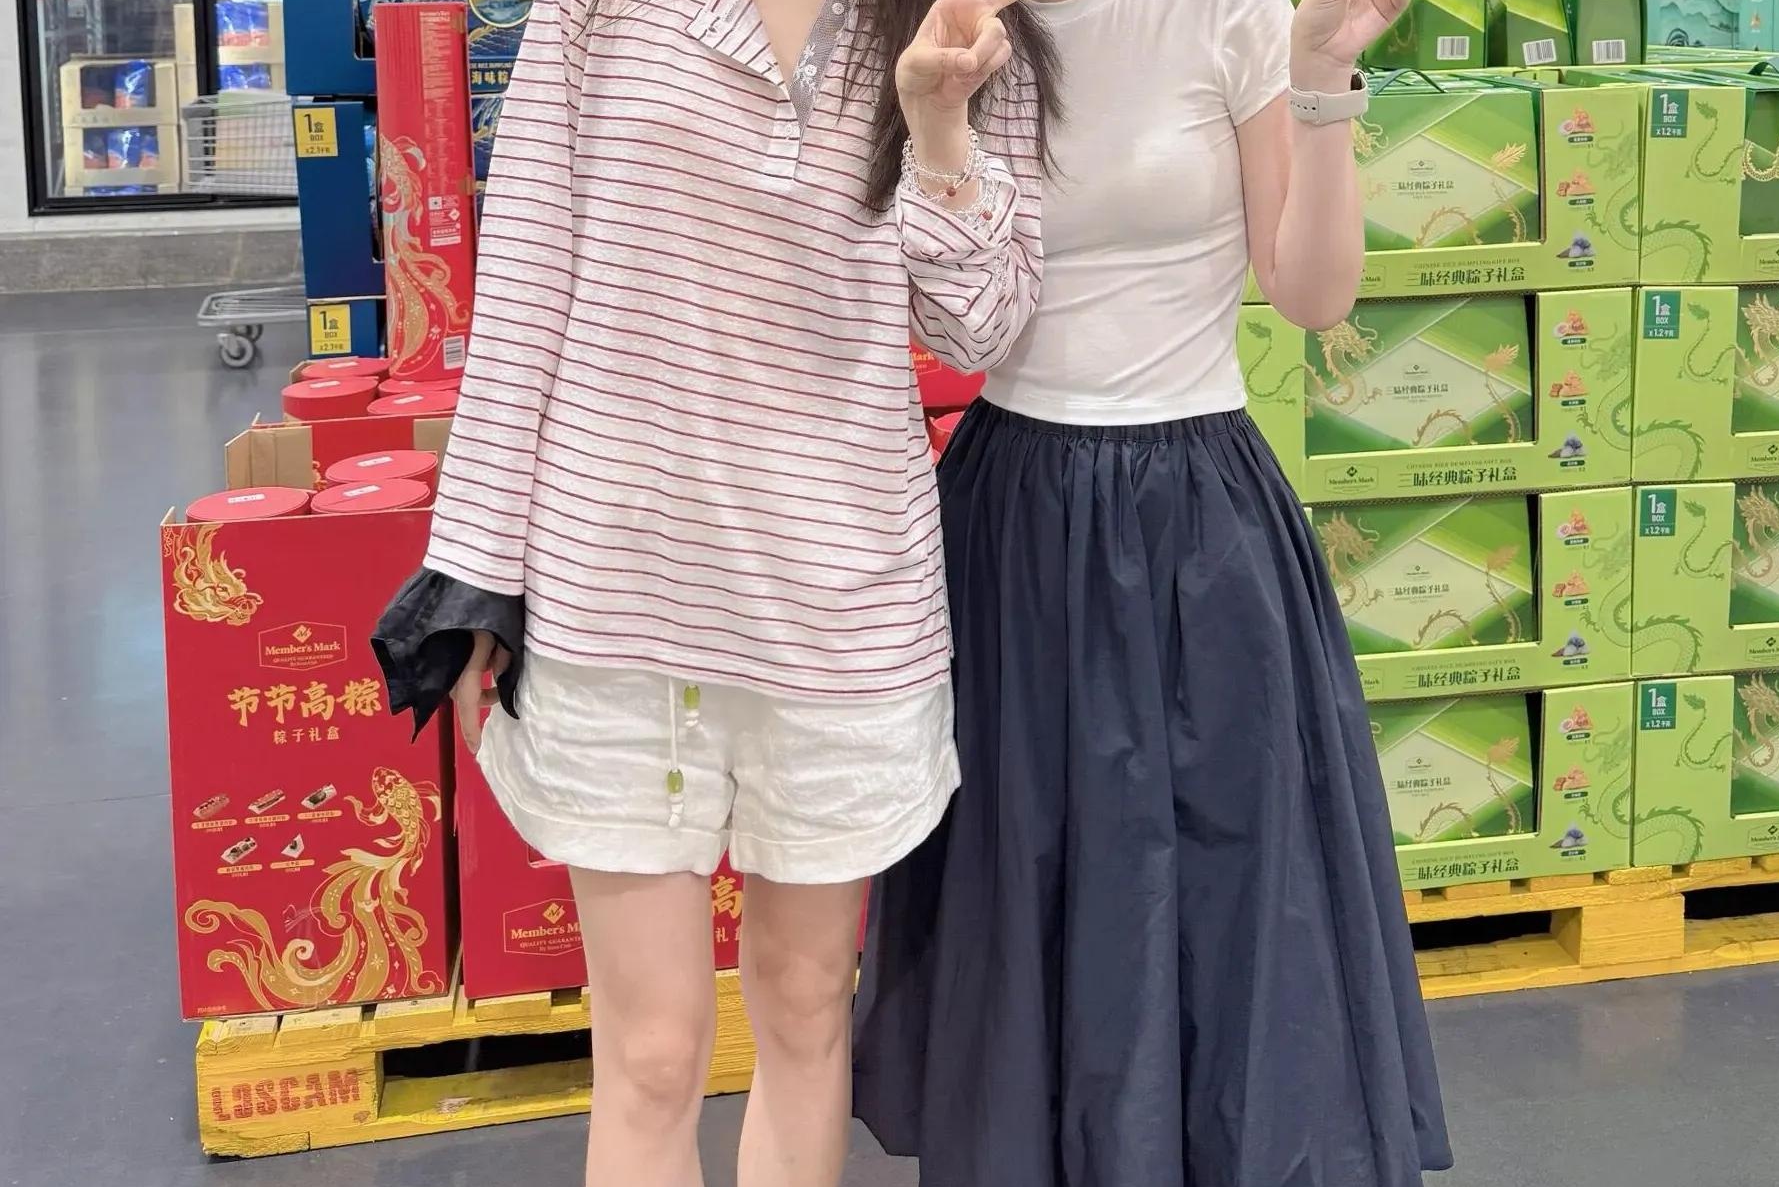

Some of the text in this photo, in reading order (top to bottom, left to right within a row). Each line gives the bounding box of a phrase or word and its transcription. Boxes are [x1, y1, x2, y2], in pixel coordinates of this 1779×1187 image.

[1660, 94, 1679, 114] 1盒
[1405, 266, 1525, 287] 三味经典粽子礼盒
[1652, 295, 1671, 315] 1盒
[1398, 467, 1517, 488] 三味经典粽子礼盒
[1648, 494, 1666, 513] 1盒
[265, 641, 340, 656] Member's Mark
[1403, 666, 1520, 689] 三味经典粽子礼盒
[227, 678, 382, 727] 节节高粽
[1648, 688, 1667, 707] 1盒
[273, 726, 340, 744] 粽子礼盒
[1404, 858, 1519, 882] 三味经典粽子礼盒
[711, 875, 743, 919] 高
[511, 925, 565, 939] Member's
[212, 1067, 361, 1121] LOSCAM
